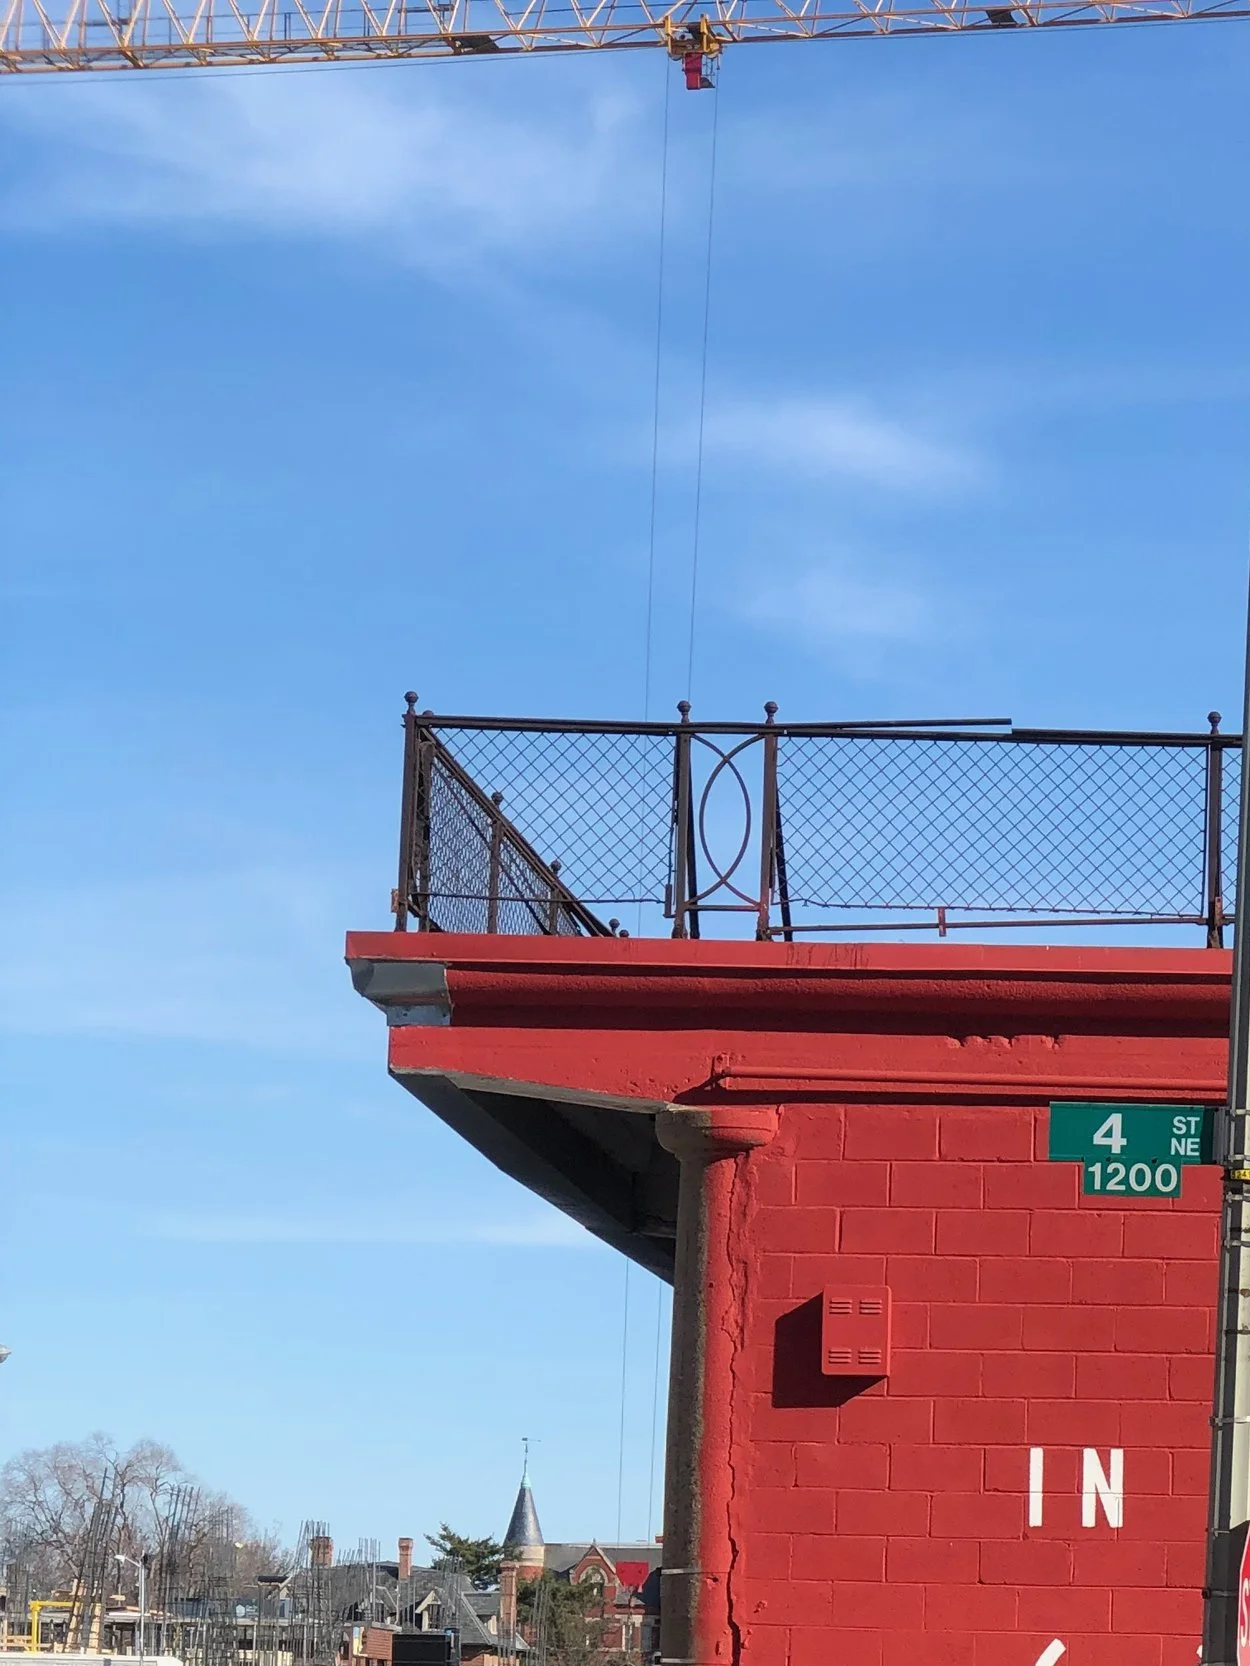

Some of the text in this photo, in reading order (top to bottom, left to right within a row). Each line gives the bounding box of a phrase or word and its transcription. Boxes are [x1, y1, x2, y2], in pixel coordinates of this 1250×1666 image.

[1093, 1113, 1128, 1155] 4
[1172, 1116, 1200, 1135] ST
[1170, 1137, 1200, 1156] NE
[1088, 1162, 1178, 1192] 1200
[1029, 1447, 1124, 1528] IN
